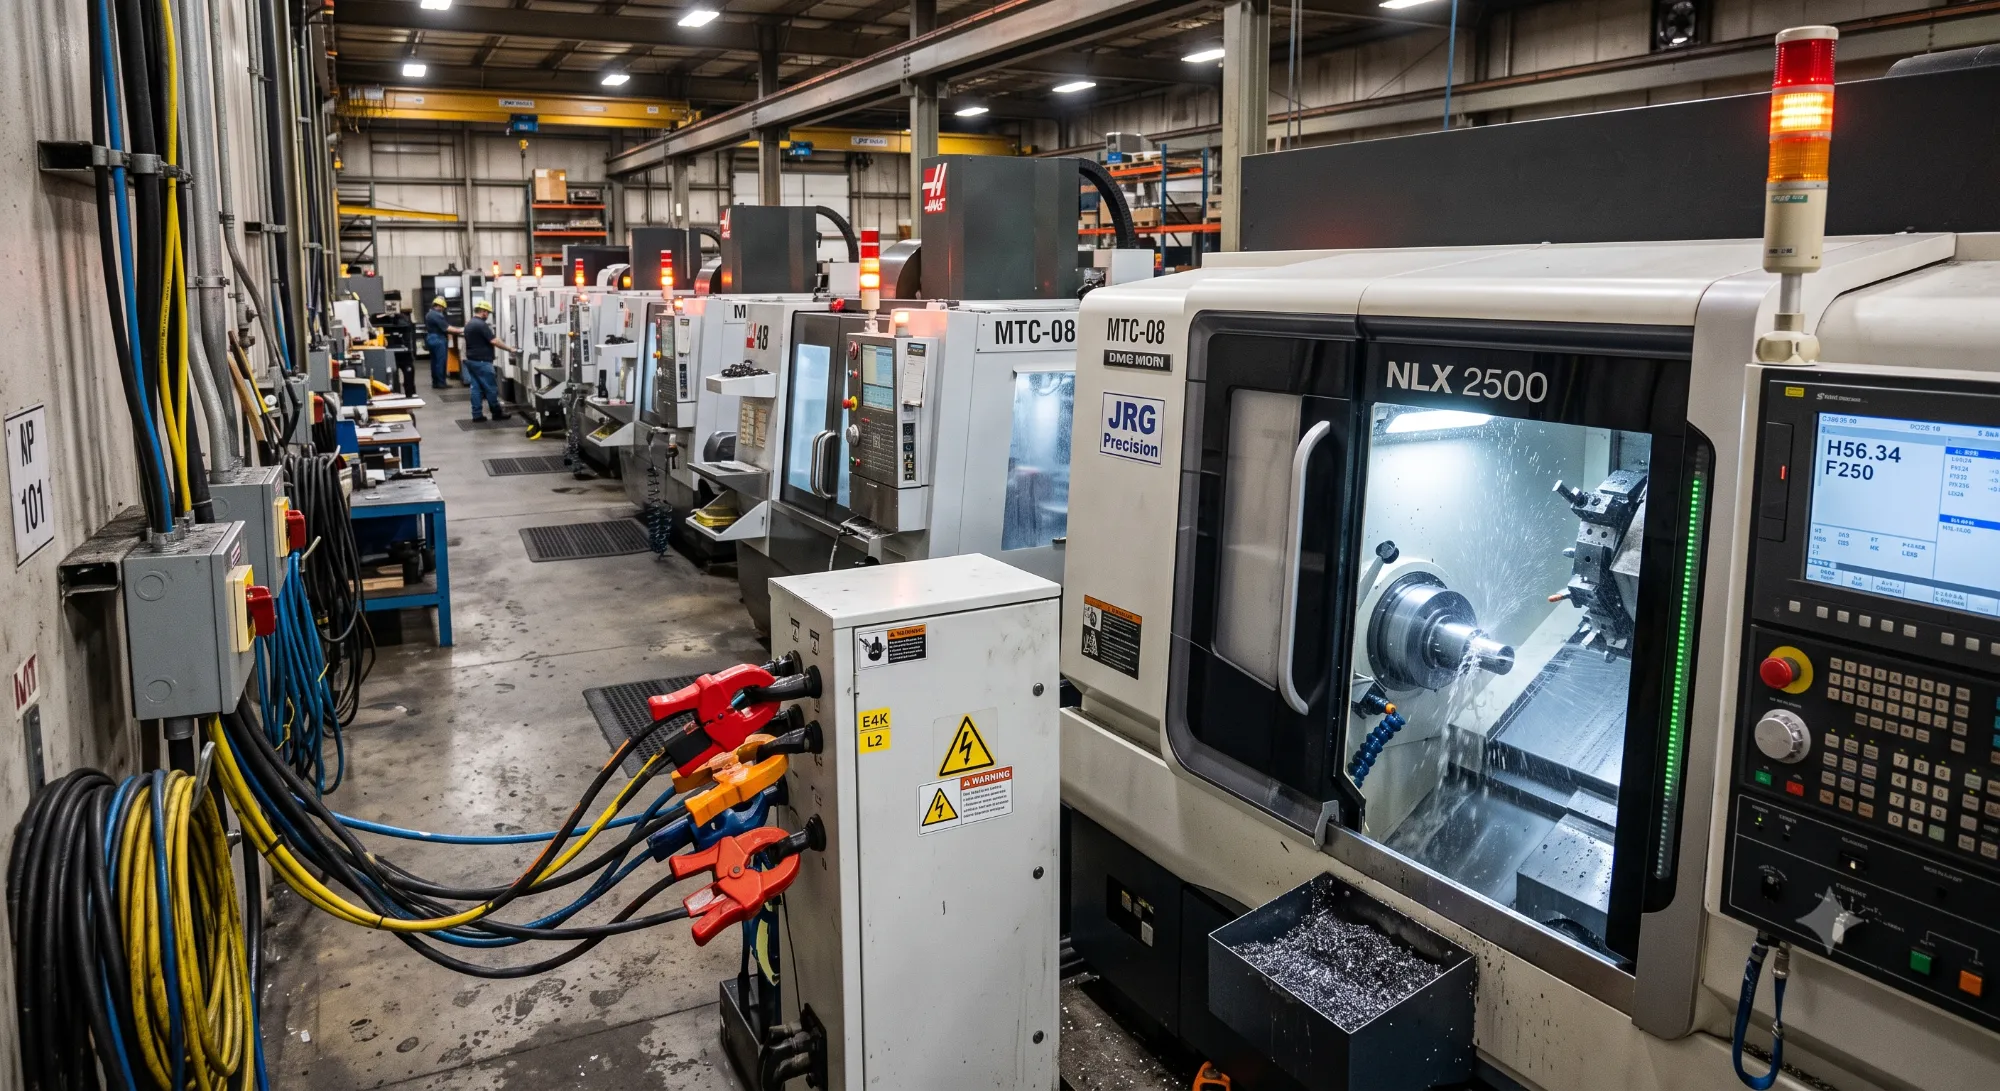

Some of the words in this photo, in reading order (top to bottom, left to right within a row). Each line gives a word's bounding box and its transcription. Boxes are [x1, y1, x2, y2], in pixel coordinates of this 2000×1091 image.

[995, 319, 1076, 345] MTC-08
[1107, 317, 1165, 345] MTC-08
[1386, 360, 1454, 394] NLX
[1462, 367, 1548, 403] 2500
[1108, 400, 1156, 435] JRG
[1103, 432, 1158, 458] Precision
[1827, 439, 1901, 463] H56.34
[1825, 459, 1874, 481] F250
[21, 478, 45, 534] 101
[863, 712, 888, 728] E4K
[867, 734, 883, 748] L2
[971, 770, 1010, 785] WARNING
